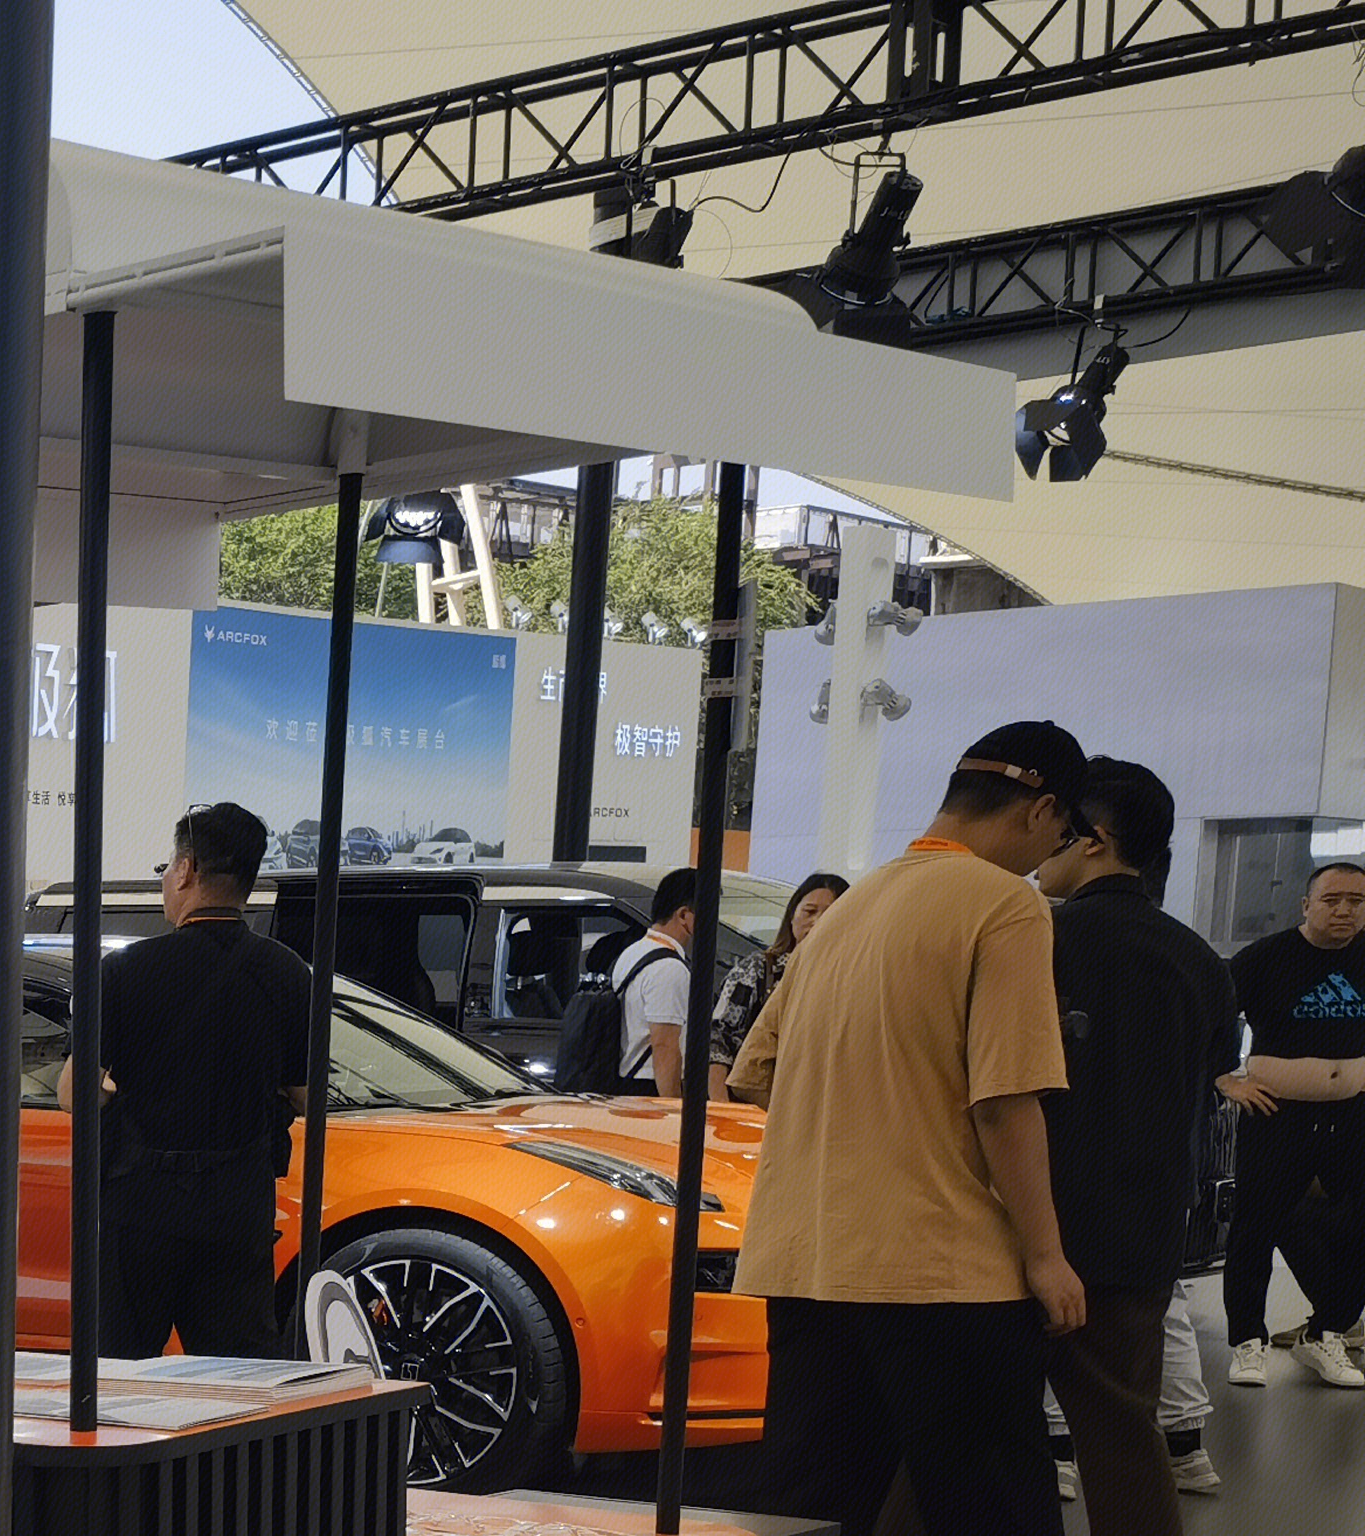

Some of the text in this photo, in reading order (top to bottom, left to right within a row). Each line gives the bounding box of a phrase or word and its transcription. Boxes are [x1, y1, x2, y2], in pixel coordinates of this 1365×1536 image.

[216, 629, 268, 646] ARCFOX
[615, 721, 681, 758] 极智守护
[590, 807, 630, 818] RCFOX
